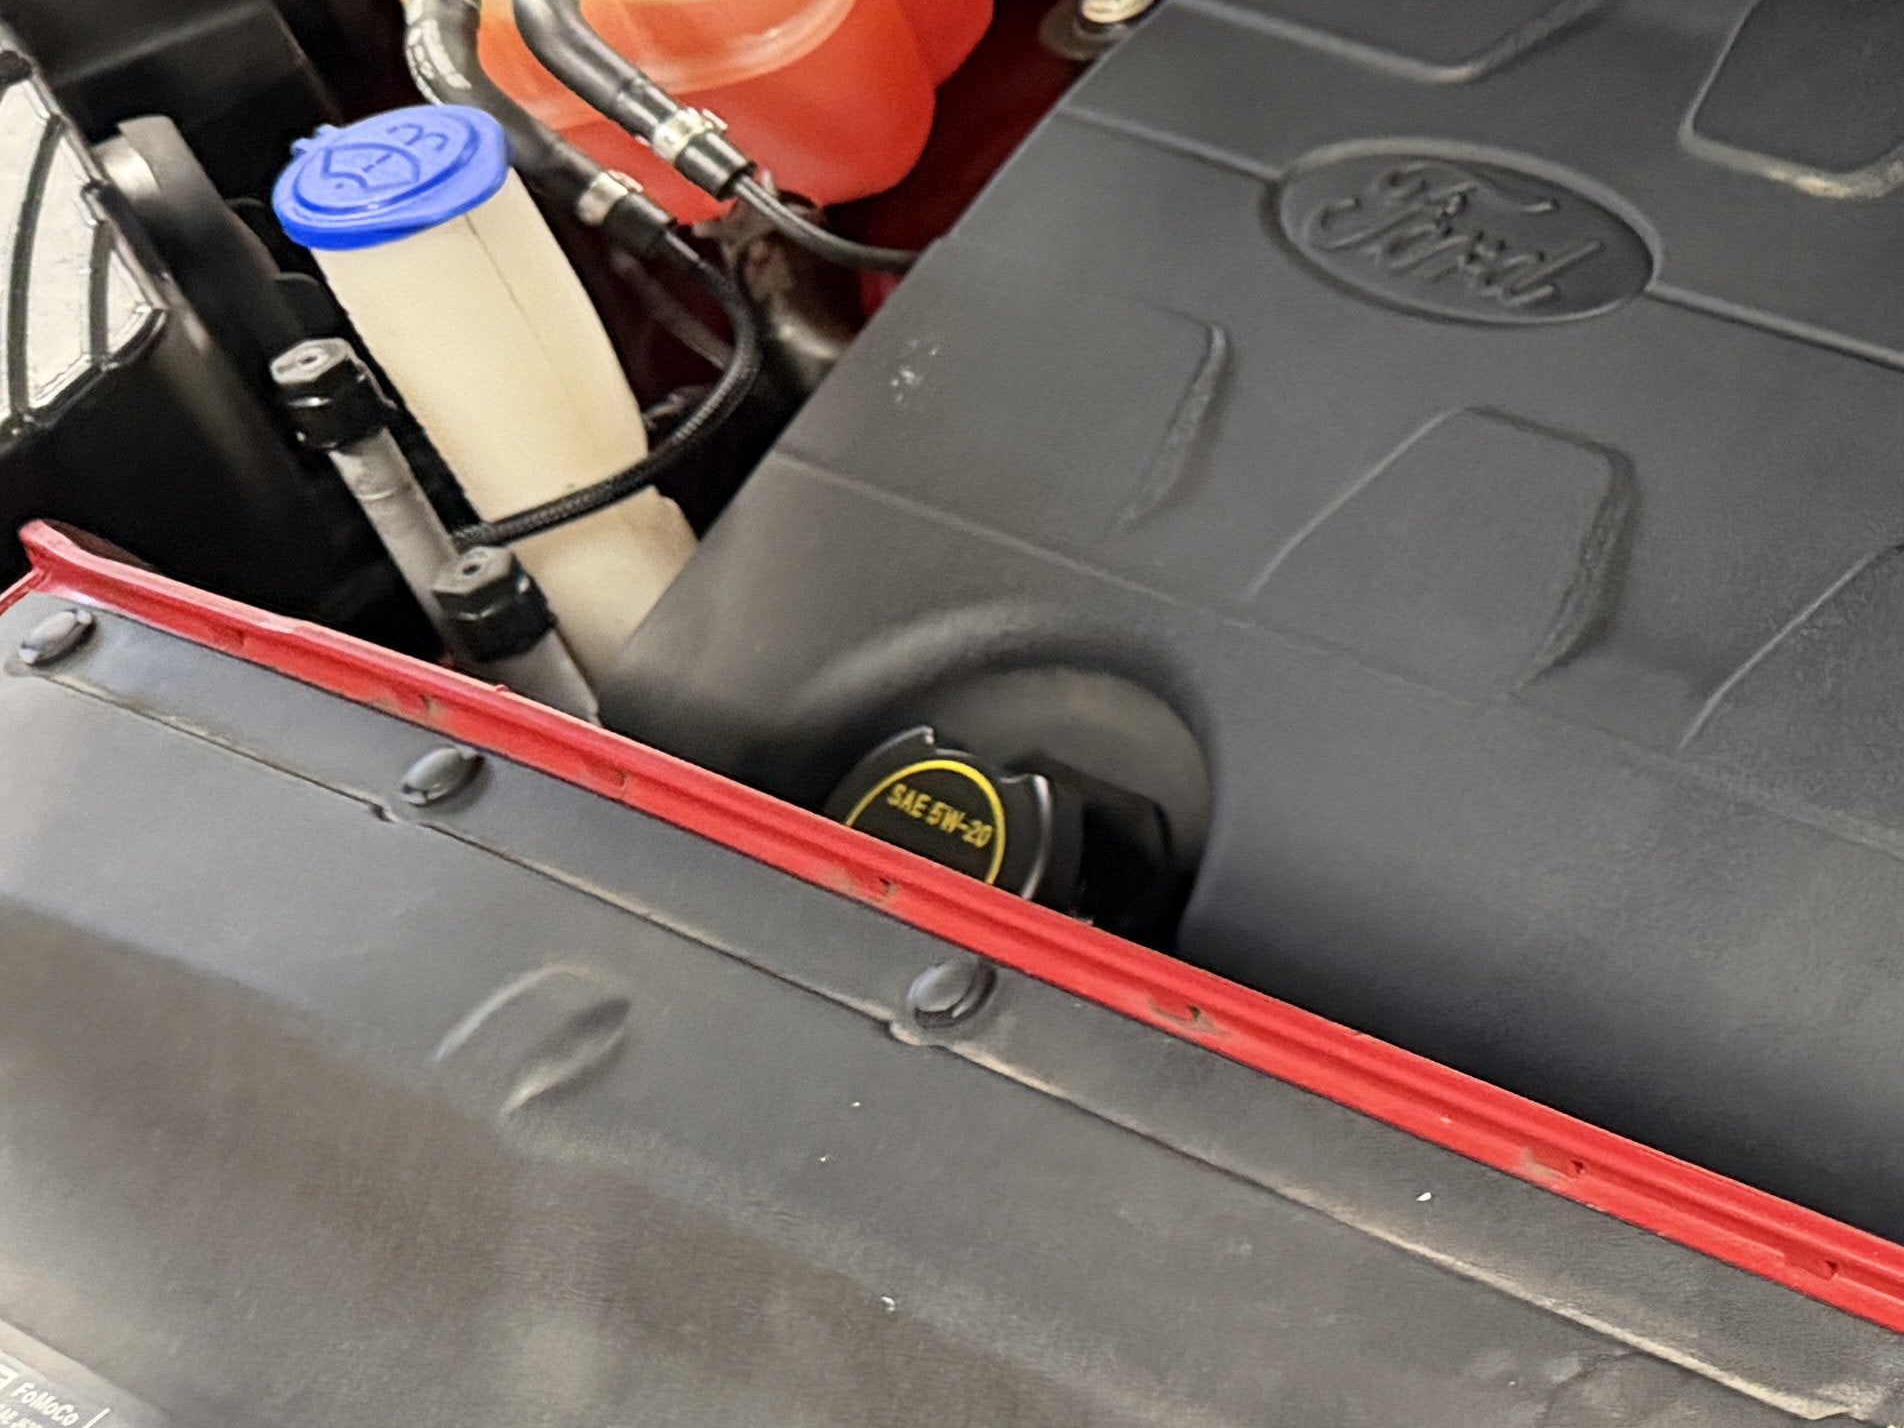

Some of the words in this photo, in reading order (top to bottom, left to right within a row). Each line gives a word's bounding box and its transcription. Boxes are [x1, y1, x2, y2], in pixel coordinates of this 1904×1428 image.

[1303, 160, 1606, 307] Ford
[887, 783, 932, 819] SAE
[926, 801, 993, 848] 5W-20
[10, 1382, 79, 1427] FoMoCo
